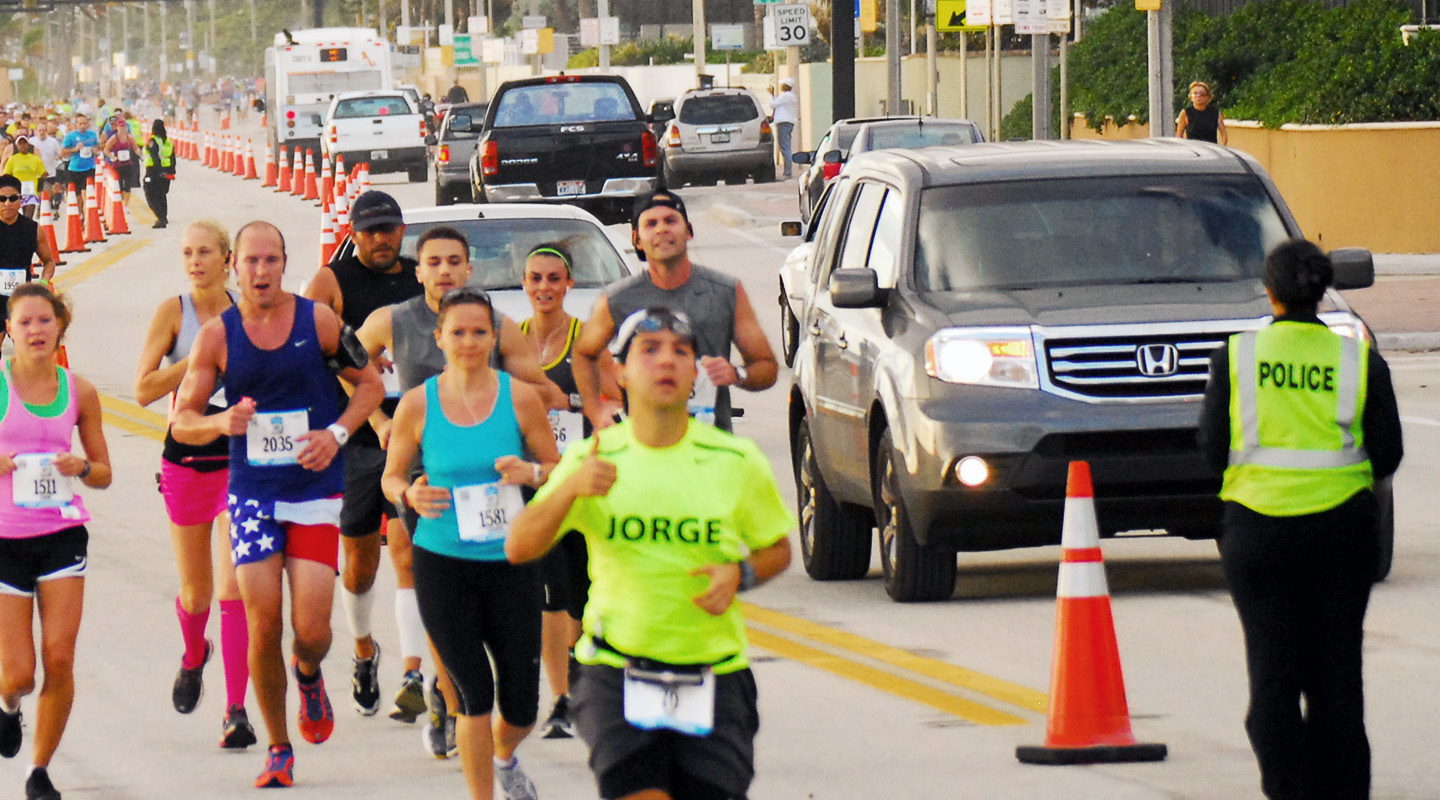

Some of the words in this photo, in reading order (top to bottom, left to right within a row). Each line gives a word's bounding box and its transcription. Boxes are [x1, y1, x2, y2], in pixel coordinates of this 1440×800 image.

[777, 8, 806, 16] SPEED
[780, 16, 802, 24] LIMIT
[780, 25, 806, 41] 30
[1258, 362, 1335, 392] POLICE
[262, 435, 294, 453] 2035
[34, 478, 57, 495] 1511
[479, 508, 507, 528] 1581
[606, 515, 721, 544] JORGE
